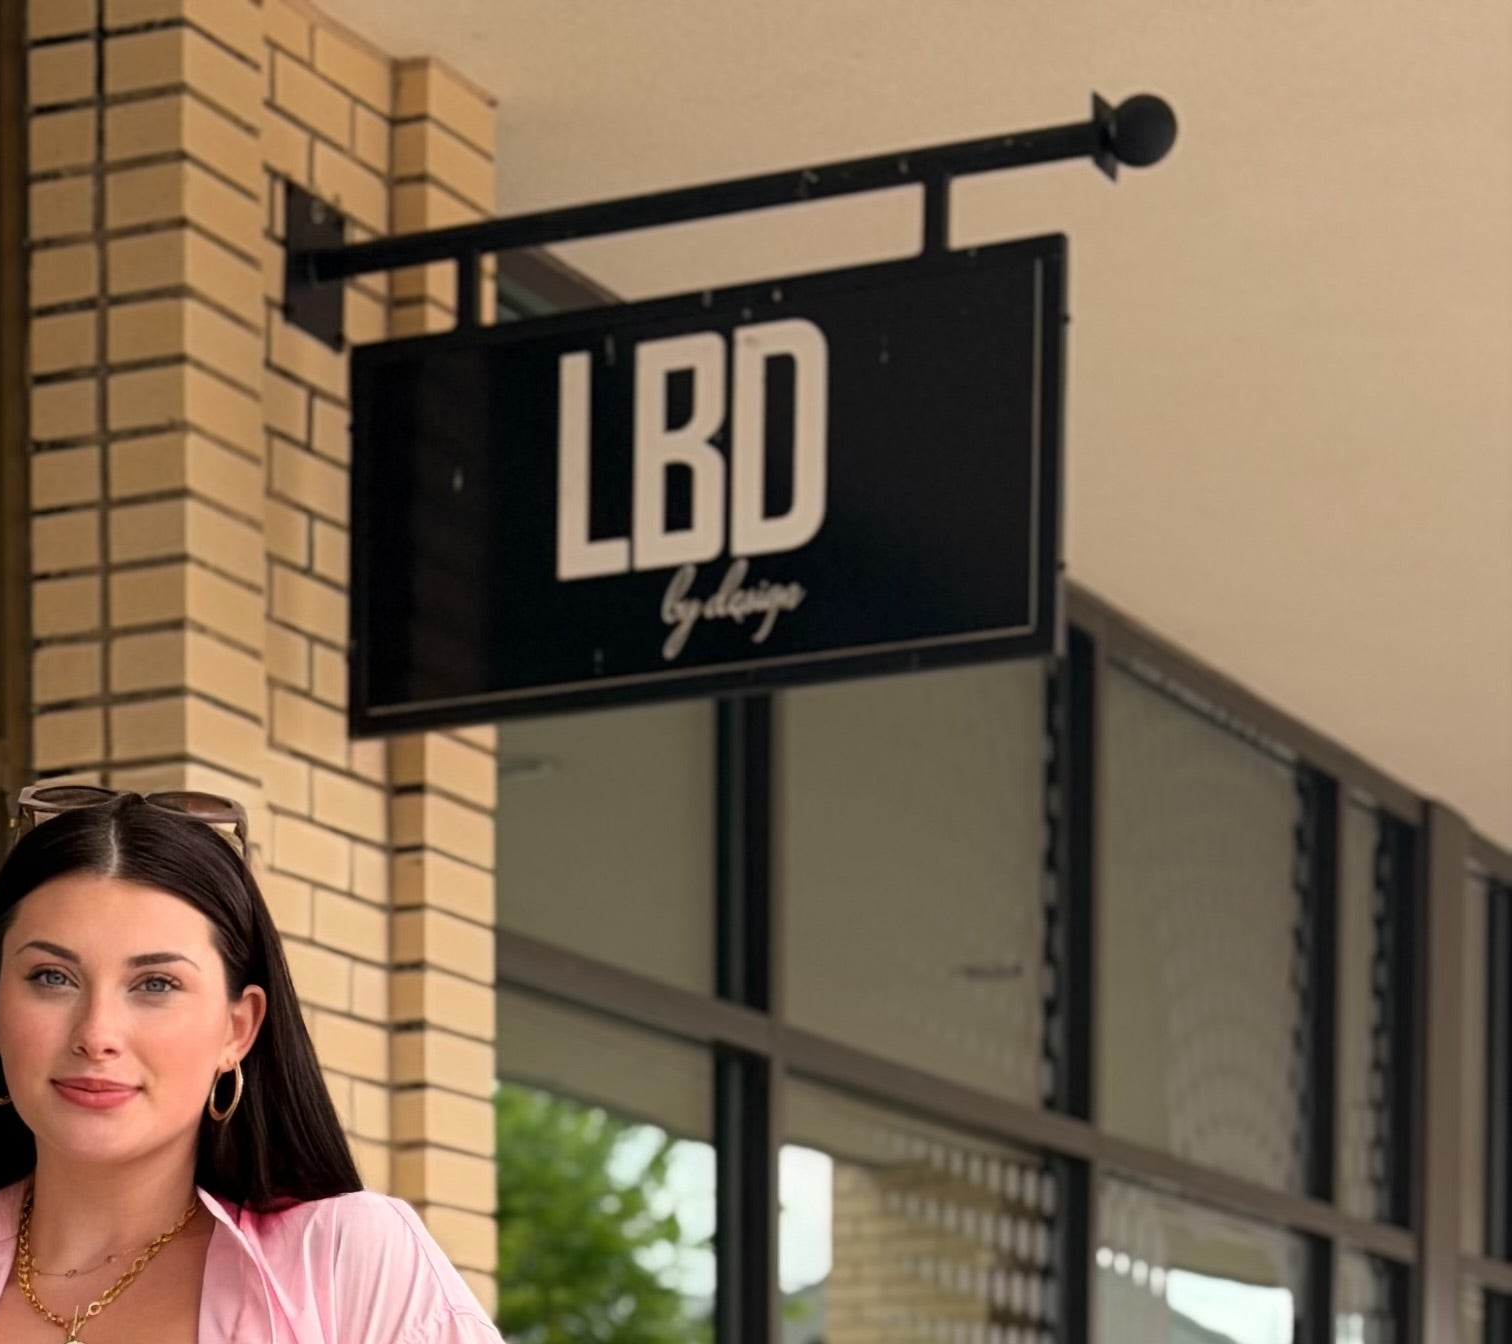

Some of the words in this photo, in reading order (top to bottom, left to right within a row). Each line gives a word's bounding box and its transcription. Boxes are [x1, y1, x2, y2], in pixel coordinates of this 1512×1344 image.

[558, 319, 827, 581] LBD
[660, 563, 701, 661] by
[703, 558, 807, 644] design
